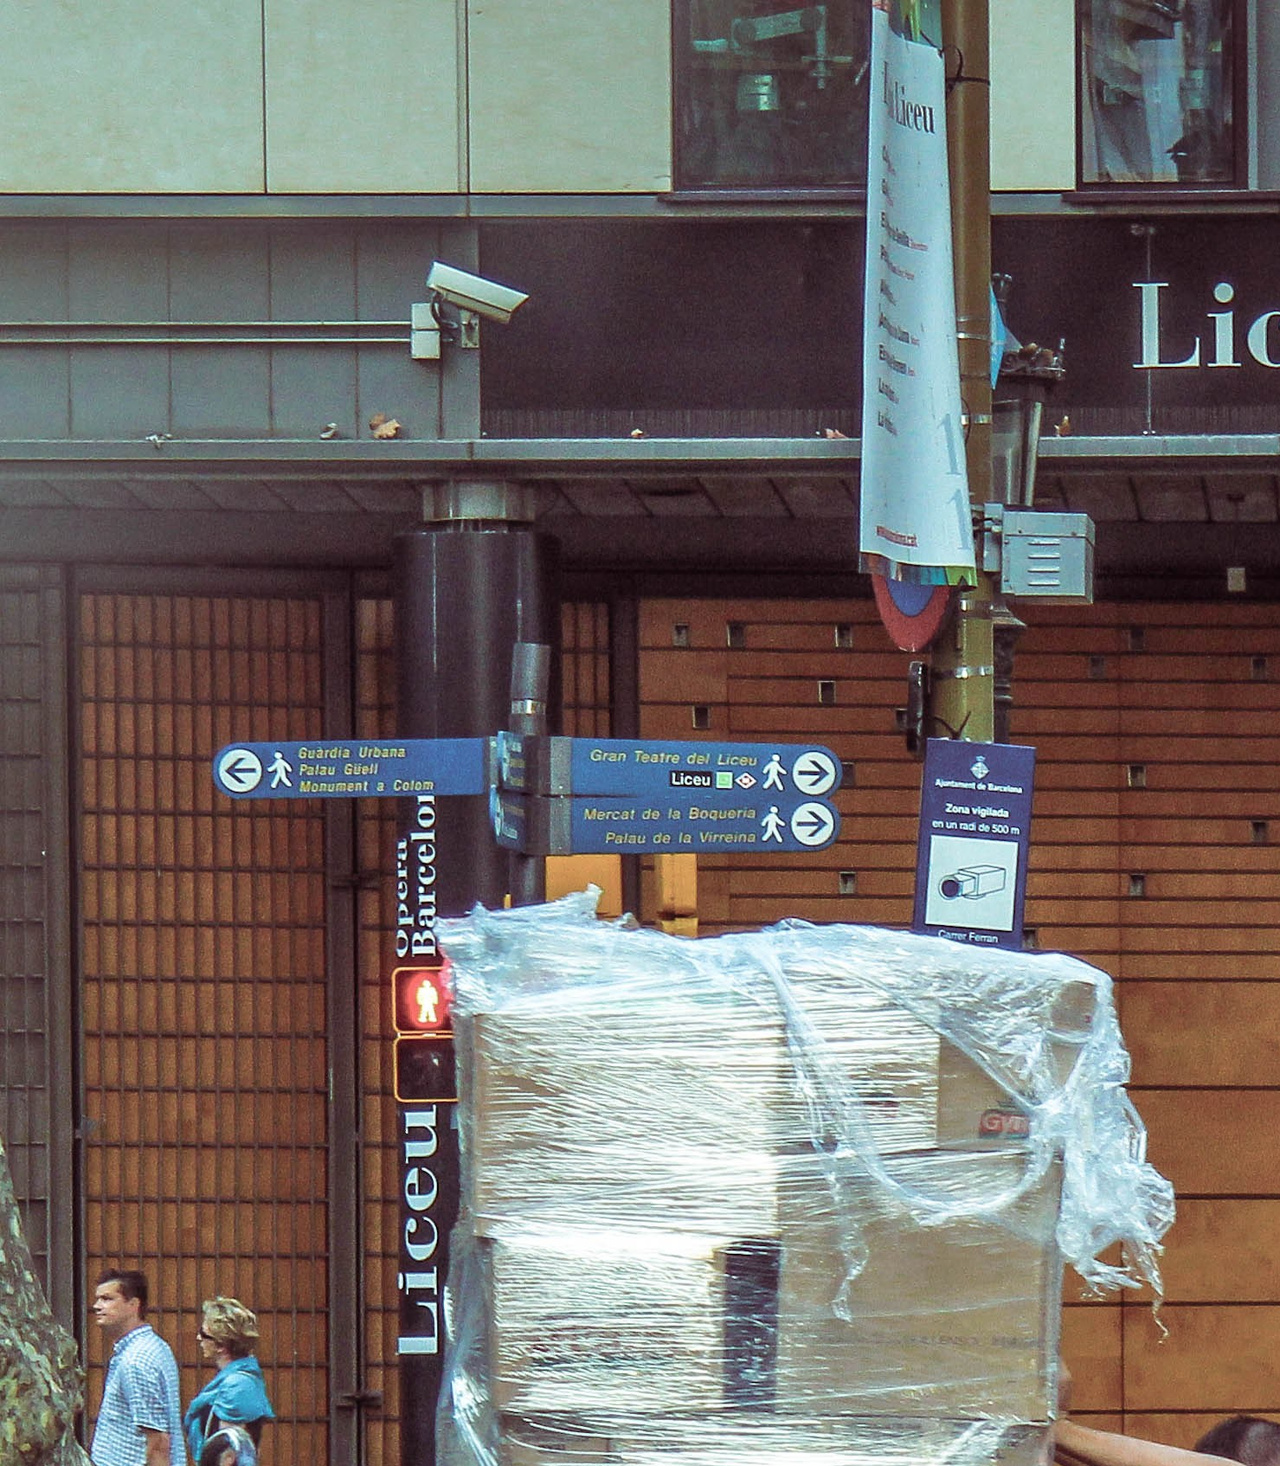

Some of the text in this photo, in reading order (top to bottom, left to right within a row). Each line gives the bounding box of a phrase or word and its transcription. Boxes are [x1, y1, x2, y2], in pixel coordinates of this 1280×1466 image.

[298, 746, 406, 759] Guàrdia Urbana
[590, 749, 758, 766] Gran Teatre del Liceu
[299, 762, 378, 777] Palau Güell
[300, 779, 435, 793] Monument a Colom
[671, 772, 712, 787] Liceu
[934, 778, 1023, 794] Ajuntament de Barcelona
[584, 807, 757, 822] Mercat de la Boqueria
[945, 803, 1010, 819] Zona vigilada
[931, 821, 1020, 835] en un radi de 500 m
[605, 831, 757, 845] Palau de la Virreina
[411, 795, 436, 957] Barcelo
[969, 931, 999, 944] Ferran
[396, 1104, 438, 1357] Liceu
